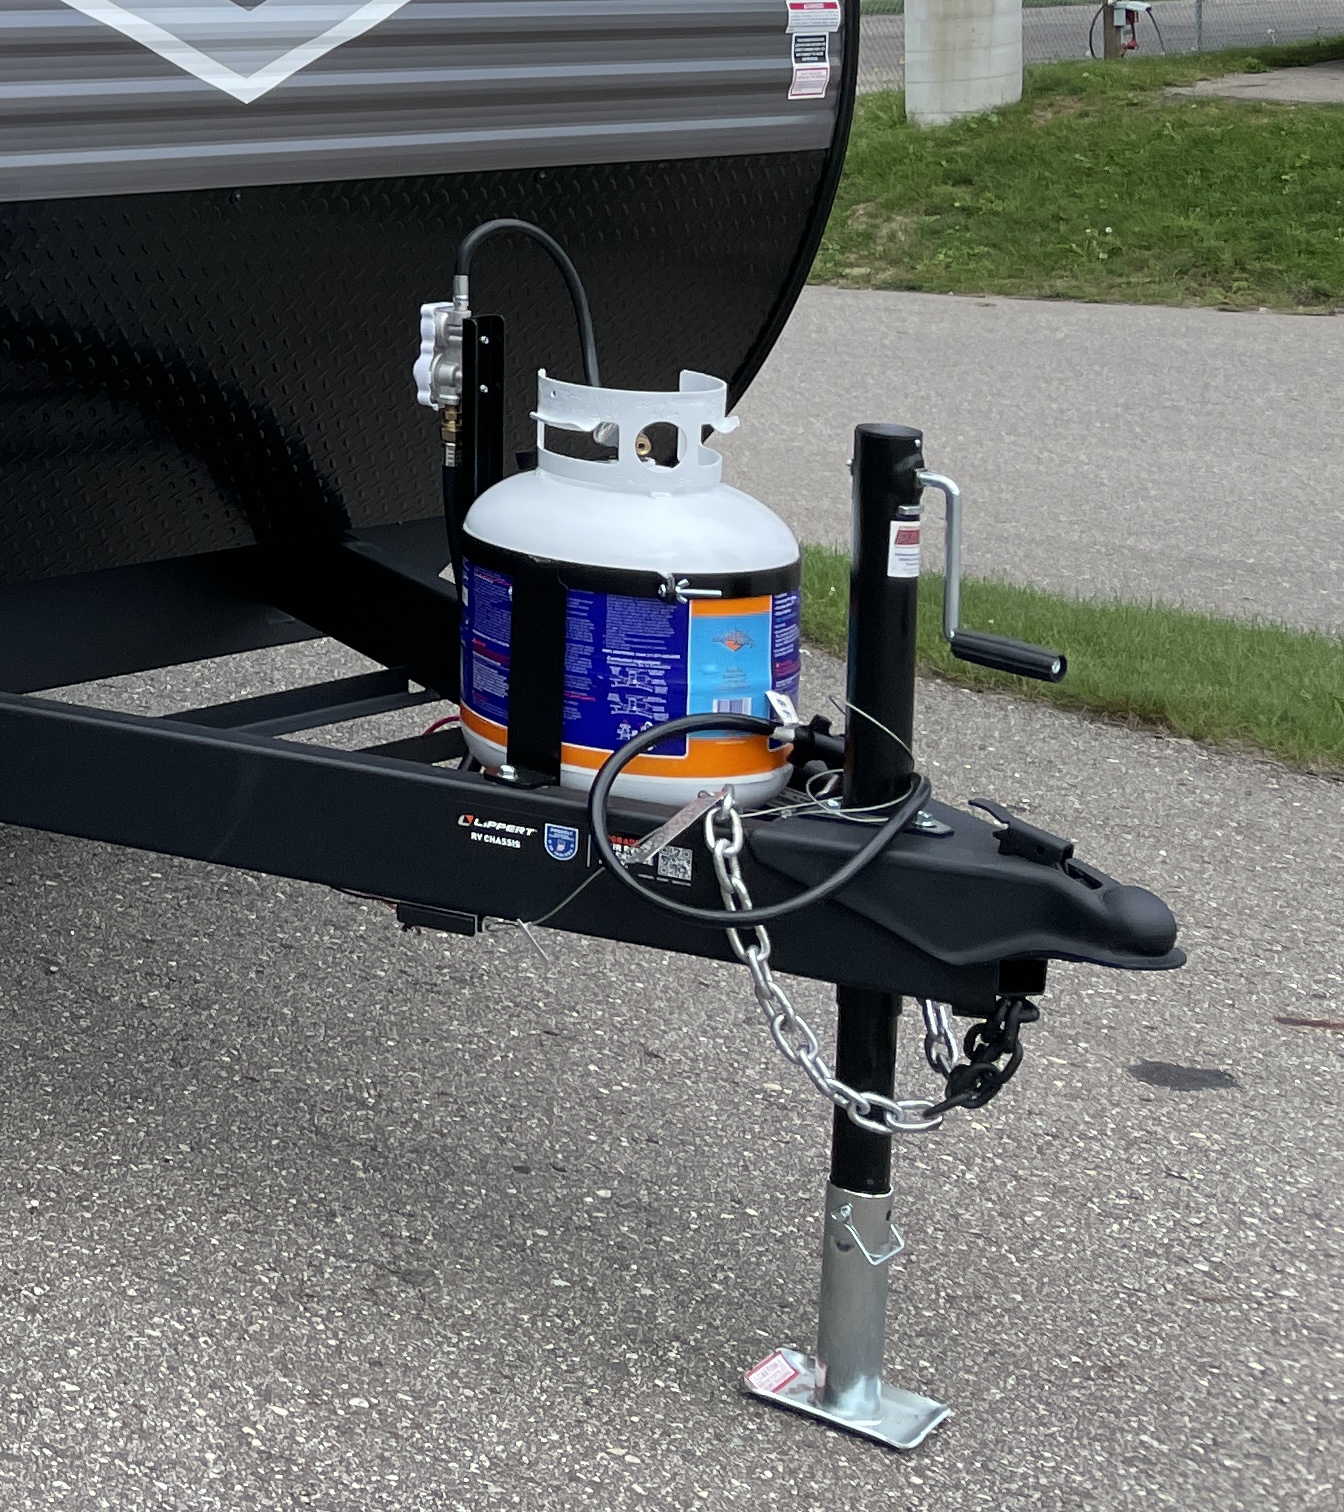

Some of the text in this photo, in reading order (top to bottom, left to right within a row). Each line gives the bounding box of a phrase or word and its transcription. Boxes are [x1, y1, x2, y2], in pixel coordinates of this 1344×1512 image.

[473, 817, 536, 837] LIPPERT
[470, 831, 522, 849] RV CHASSIS
